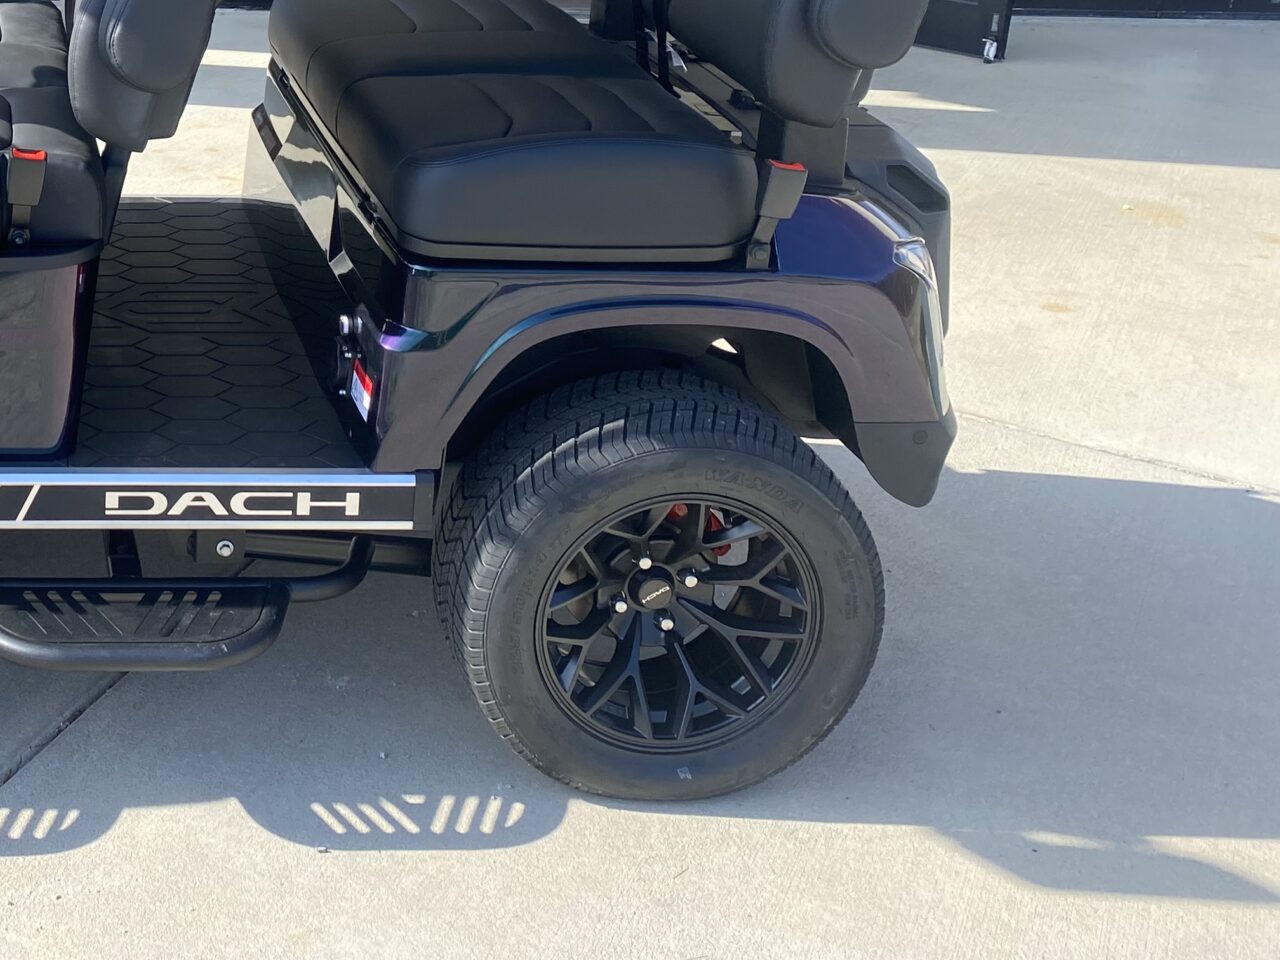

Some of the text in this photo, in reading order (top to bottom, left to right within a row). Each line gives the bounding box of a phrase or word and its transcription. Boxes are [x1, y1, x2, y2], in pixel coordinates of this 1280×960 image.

[705, 468, 803, 513] WANDA
[105, 491, 360, 516] DACH
[642, 585, 671, 604] DACH
